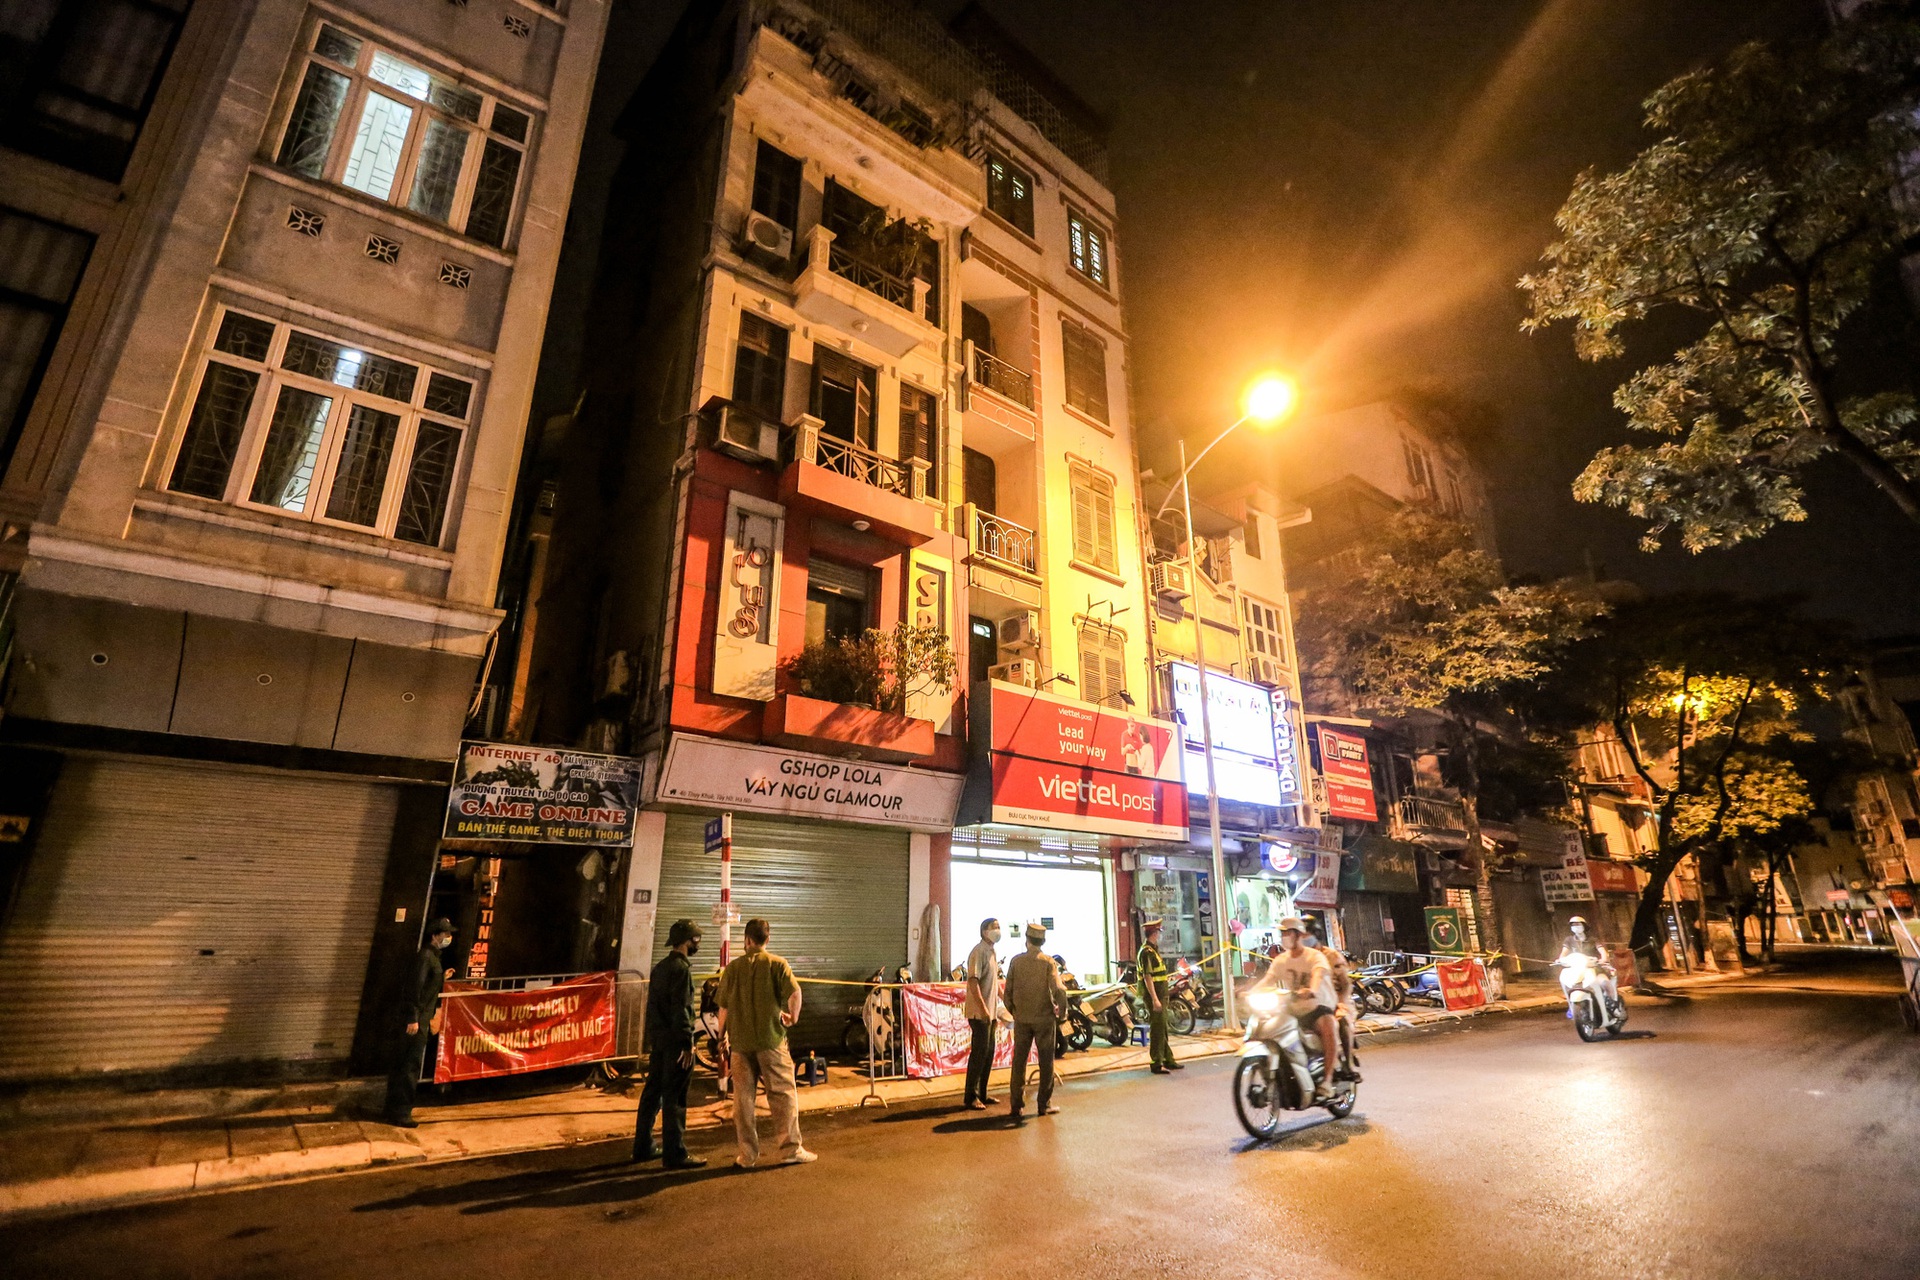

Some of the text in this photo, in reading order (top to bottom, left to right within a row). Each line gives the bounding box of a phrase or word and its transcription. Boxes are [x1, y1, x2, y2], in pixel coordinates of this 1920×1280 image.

[1058, 708, 1093, 722] viettel post
[1058, 723, 1084, 740] Lead
[470, 746, 561, 765] INTERNET 46
[1059, 740, 1107, 761] your way
[780, 759, 882, 786] GSHOP LOLA
[464, 782, 589, 802] ĐƯỜNG TRUYỀN TỐC ĐỘ CAO
[744, 776, 903, 810] VÁY NGỦ GLAMOUR
[1038, 774, 1157, 812] viettel post
[461, 800, 626, 825] GAME ONLINE
[458, 820, 624, 842] BÁN THẺ GAME, THẺ ĐIỆN THOẠI
[484, 995, 580, 1023] KHU VỰC CÁCH LY
[454, 1031, 498, 1056] KHÔNG
[532, 1026, 550, 1049] SỰ
